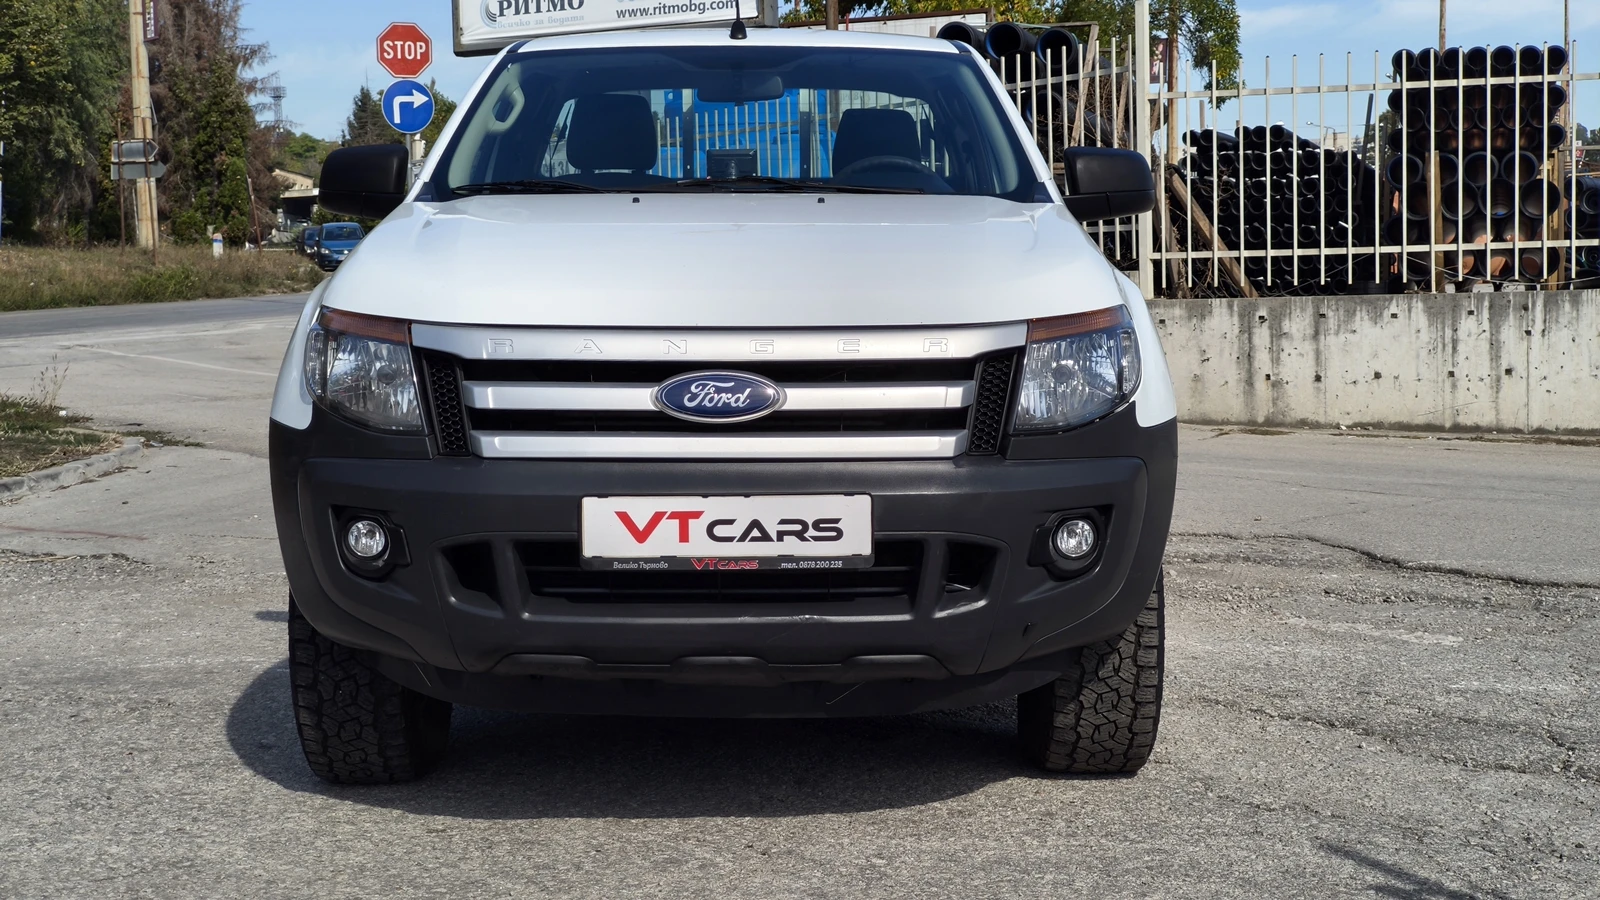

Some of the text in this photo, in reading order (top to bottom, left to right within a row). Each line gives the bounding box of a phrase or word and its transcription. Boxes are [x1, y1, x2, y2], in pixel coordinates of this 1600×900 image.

[497, 0, 585, 18] РИТМО
[616, 0, 739, 19] www.ritmobg.com
[497, 18, 531, 29] всичко
[383, 40, 426, 60] STOP
[488, 338, 949, 355] RANGER
[683, 380, 752, 408] Ford
[613, 561, 669, 570] Велико Търново
[816, 560, 830, 568] 200
[830, 560, 843, 568] 235
